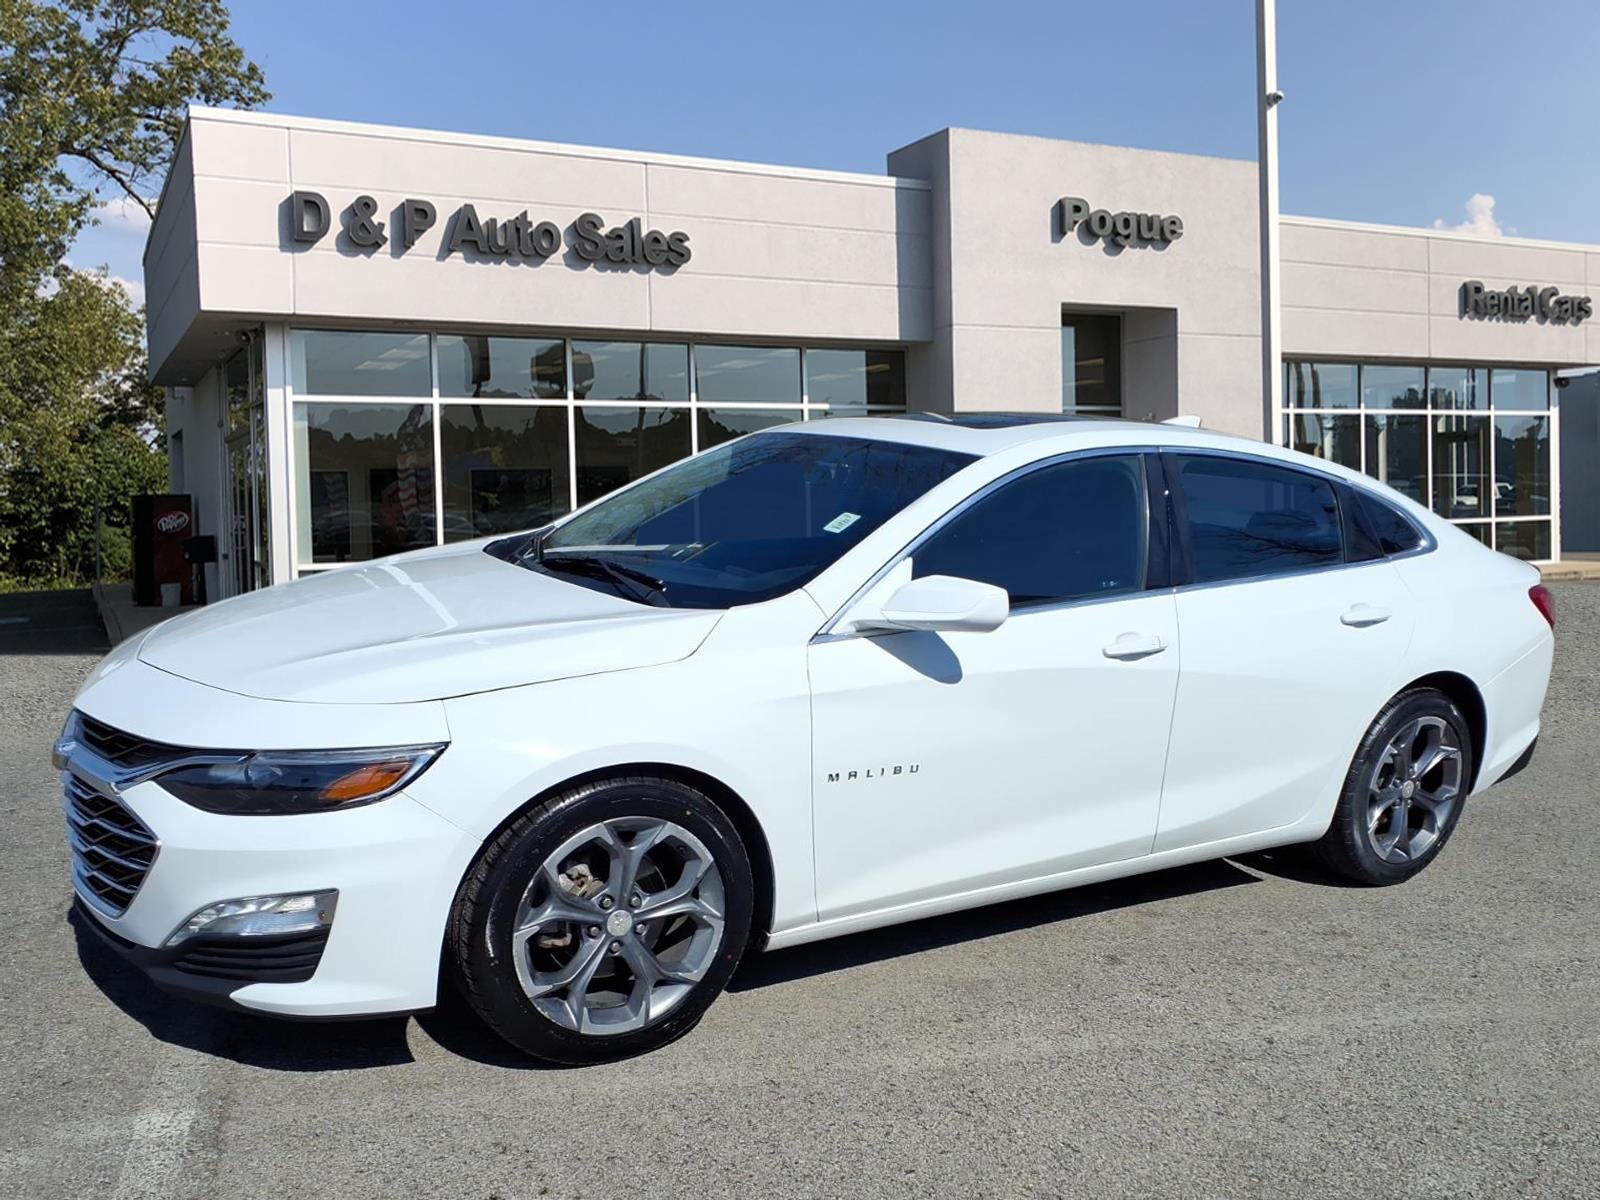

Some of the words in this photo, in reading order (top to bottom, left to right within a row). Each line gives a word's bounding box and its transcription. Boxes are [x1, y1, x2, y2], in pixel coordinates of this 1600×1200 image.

[290, 190, 331, 246] D
[346, 195, 388, 249] &
[401, 198, 437, 249] P
[446, 203, 562, 259] Auto
[570, 212, 692, 268] Sales
[1056, 196, 1184, 248] Pogue
[1461, 280, 1538, 317] Rental
[1539, 286, 1592, 320] Cars
[827, 764, 919, 783] MALIBU
